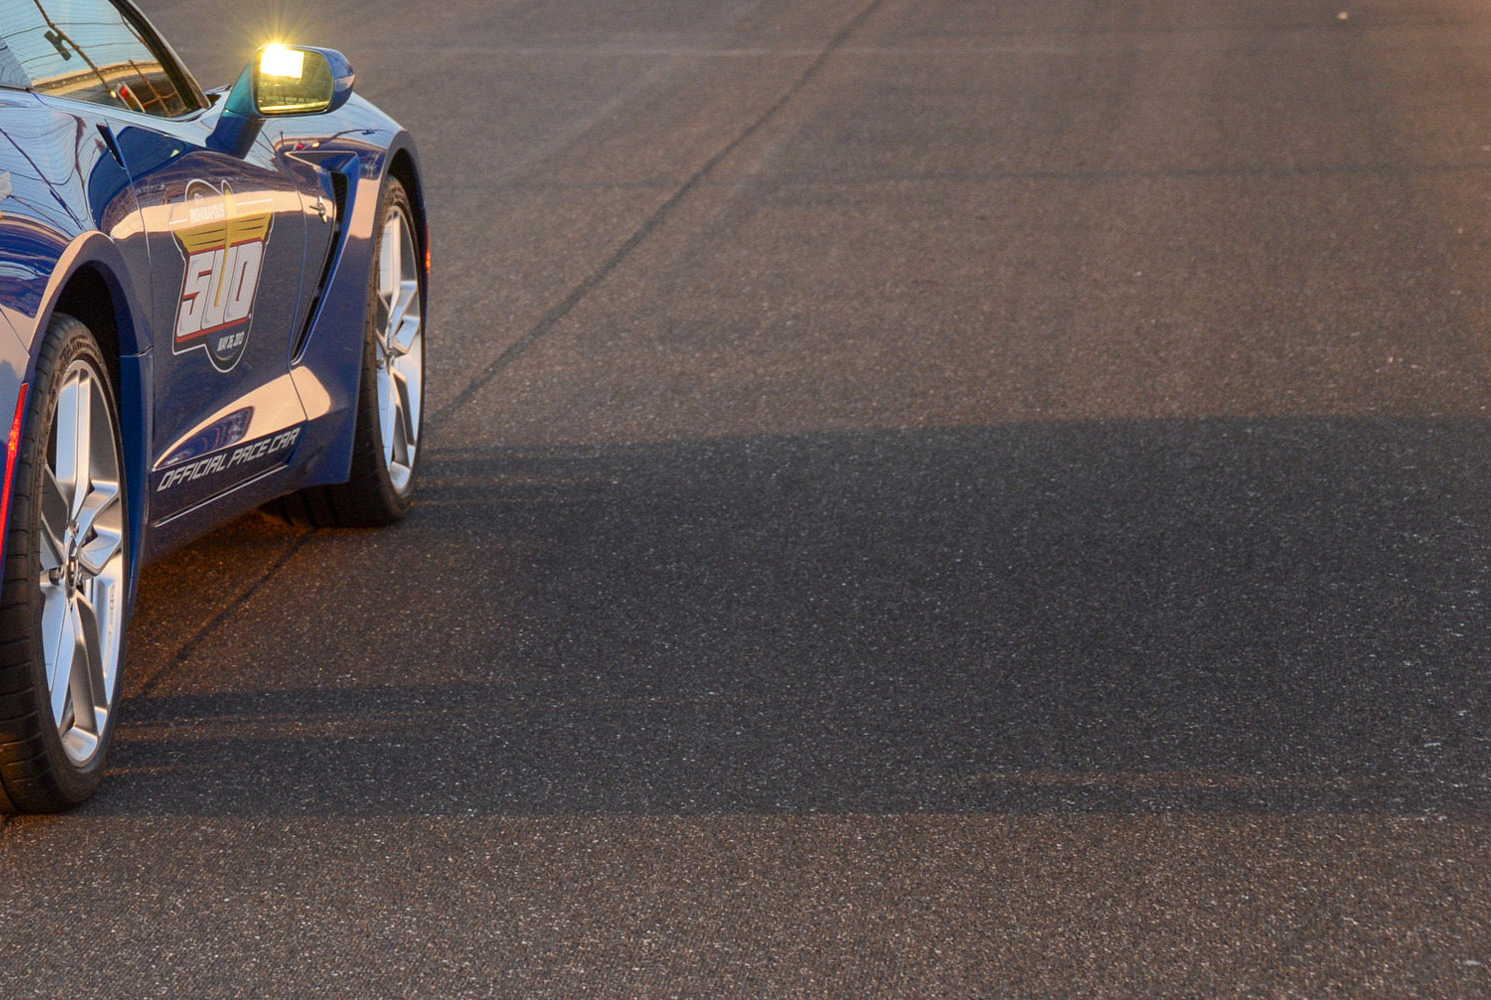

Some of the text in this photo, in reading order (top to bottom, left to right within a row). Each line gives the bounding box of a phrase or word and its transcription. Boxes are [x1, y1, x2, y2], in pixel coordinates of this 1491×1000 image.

[176, 240, 263, 337] 500
[156, 427, 301, 492] OFFICIAL PACE CAR
